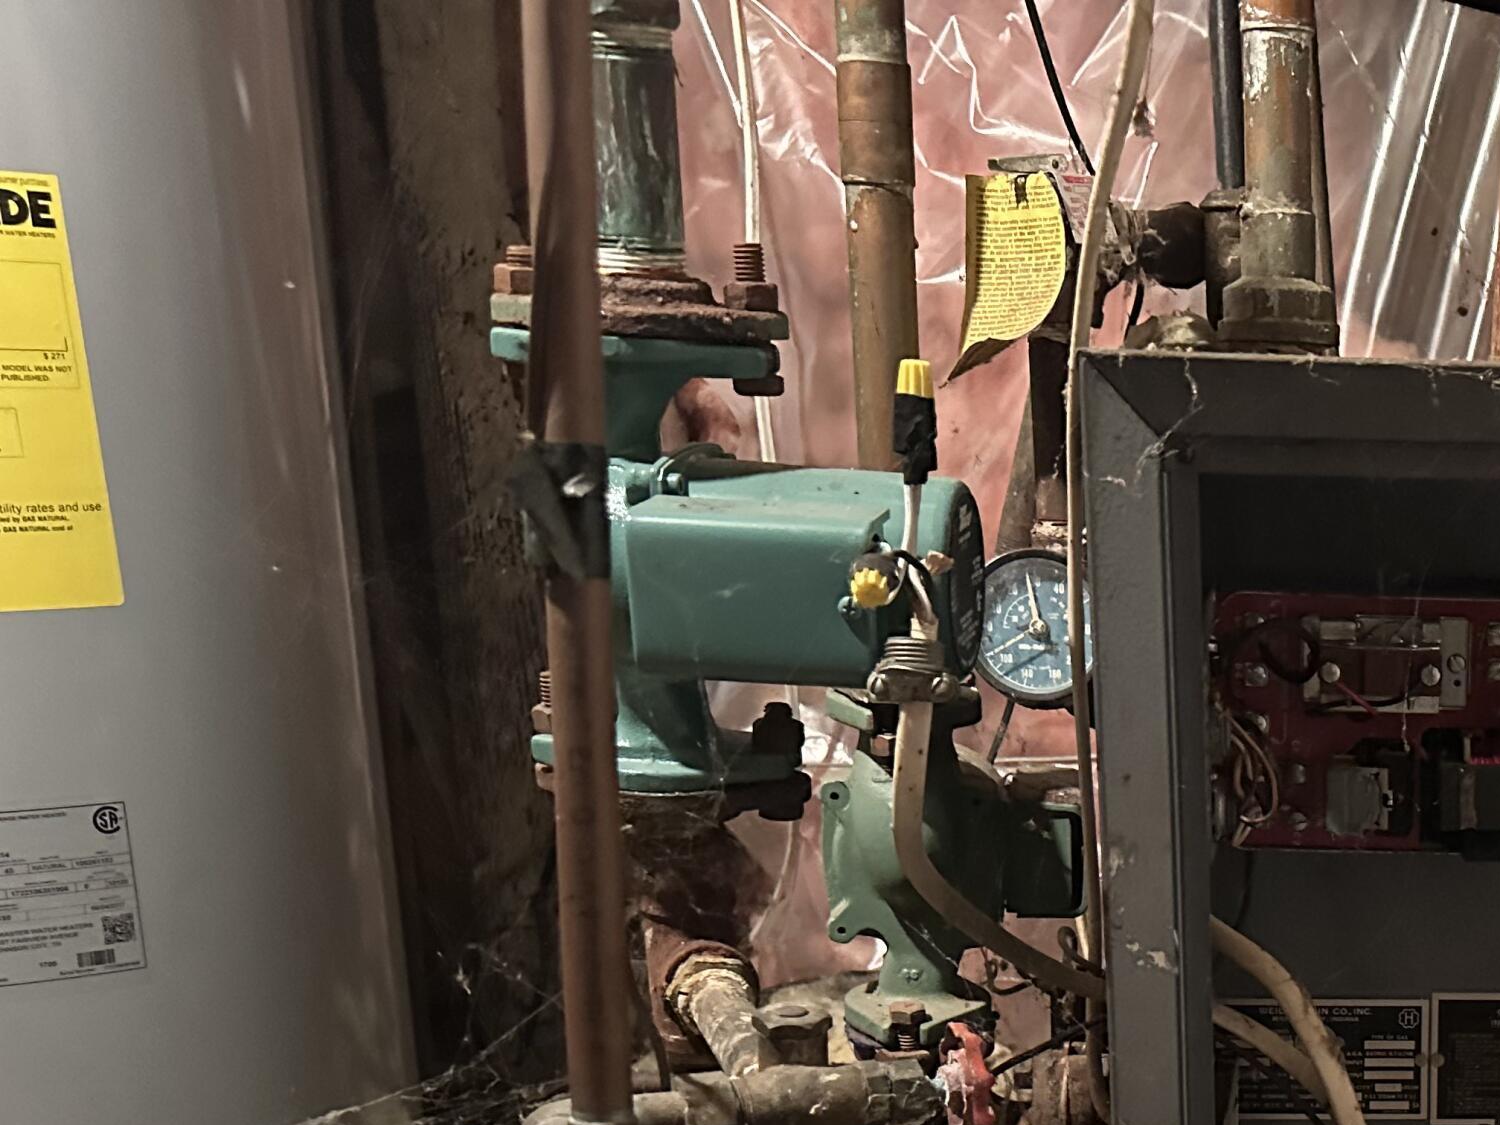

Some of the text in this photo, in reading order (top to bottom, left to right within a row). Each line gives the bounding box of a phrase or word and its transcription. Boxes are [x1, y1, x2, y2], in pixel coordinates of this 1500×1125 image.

[26, 503, 55, 513] rates
[58, 501, 79, 513] and
[82, 503, 102, 512] use
